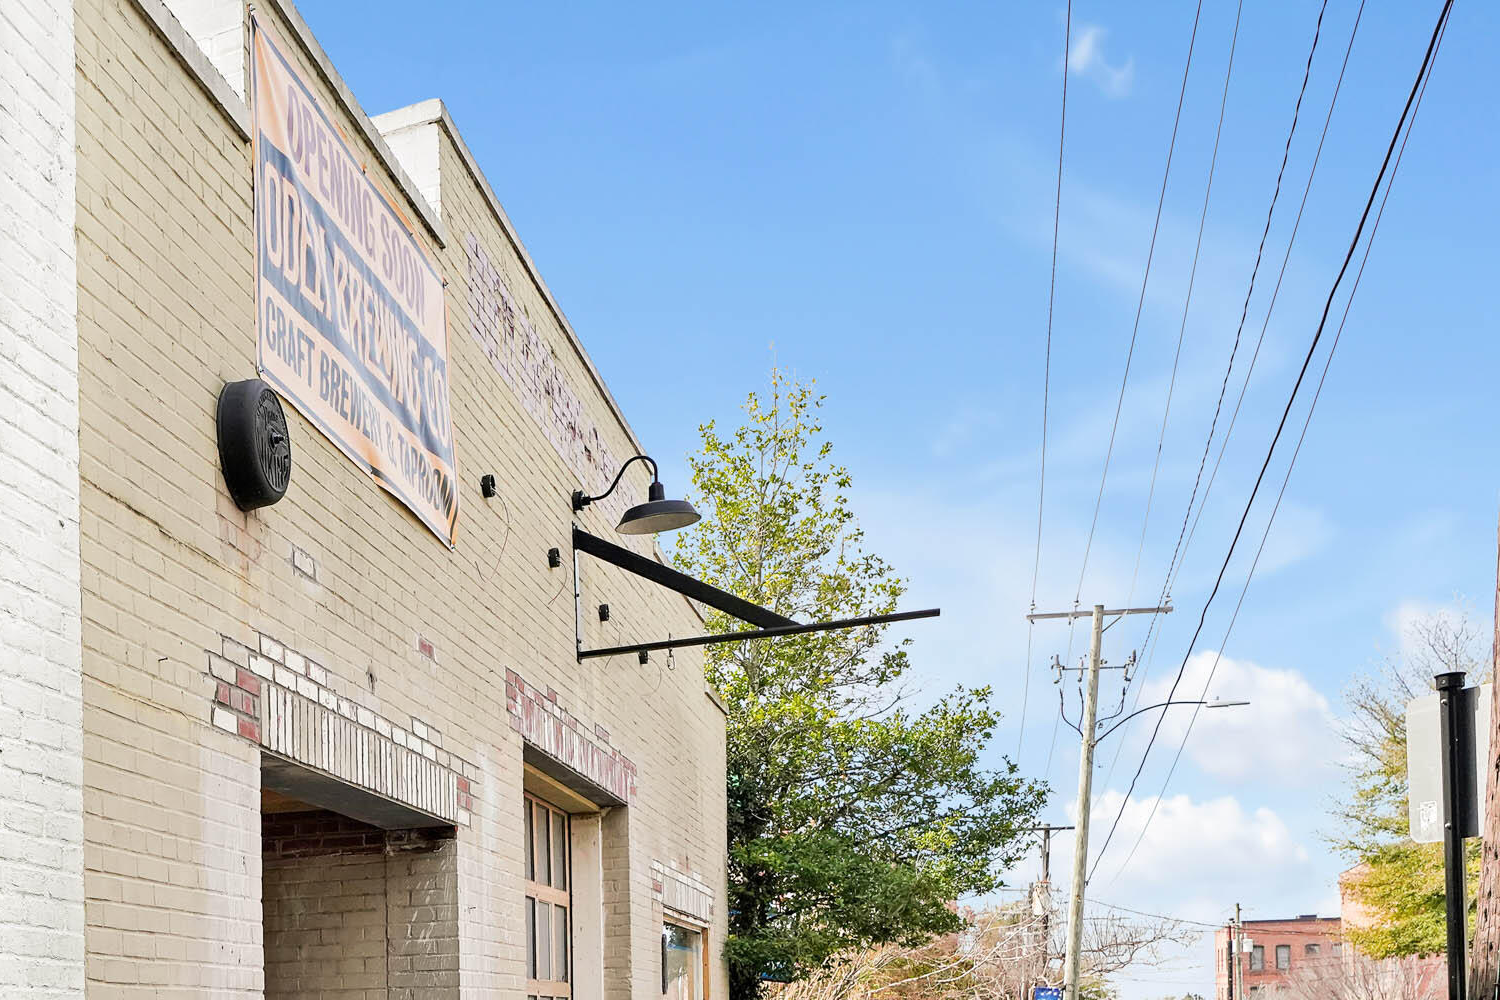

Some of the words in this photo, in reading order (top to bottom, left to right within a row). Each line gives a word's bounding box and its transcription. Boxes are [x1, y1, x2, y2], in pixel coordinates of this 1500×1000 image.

[287, 84, 376, 261] OPENING
[380, 213, 426, 326] SOON
[265, 296, 315, 389] CRAFT
[319, 350, 384, 454] BREWERY
[386, 421, 397, 467] &
[397, 432, 454, 520] TAPROOM
[333, 241, 421, 425] BREWING
